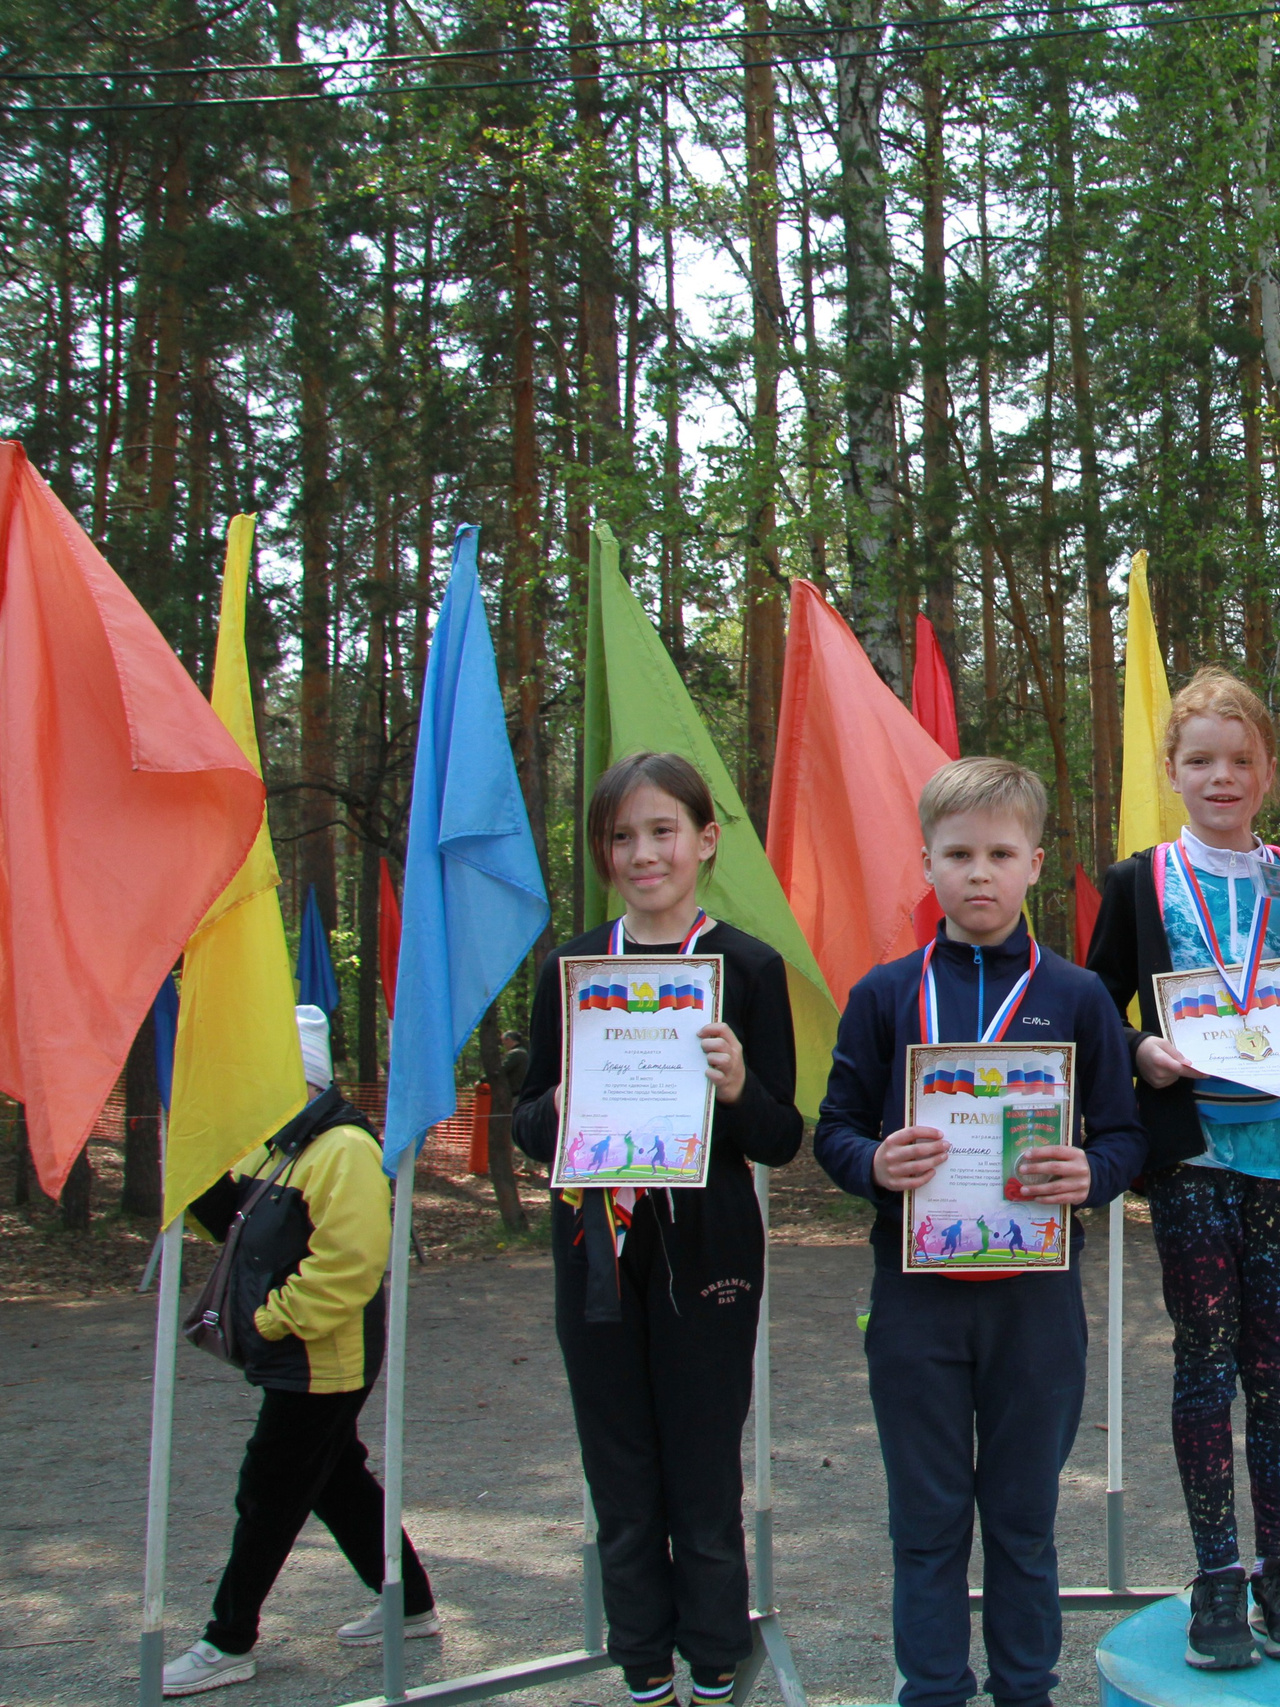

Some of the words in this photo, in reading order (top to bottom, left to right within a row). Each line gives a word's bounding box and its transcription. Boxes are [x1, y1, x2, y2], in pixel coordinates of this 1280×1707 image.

[1022, 1016, 1050, 1026] CMP
[605, 1028, 679, 1040] ГРАМОТА
[1202, 1025, 1272, 1041] ГРАМТА
[1249, 1040, 1256, 1048] 1
[638, 1059, 684, 1074] Екатерина
[700, 1278, 751, 1297] DREAMER
[718, 1296, 736, 1304] DAY
